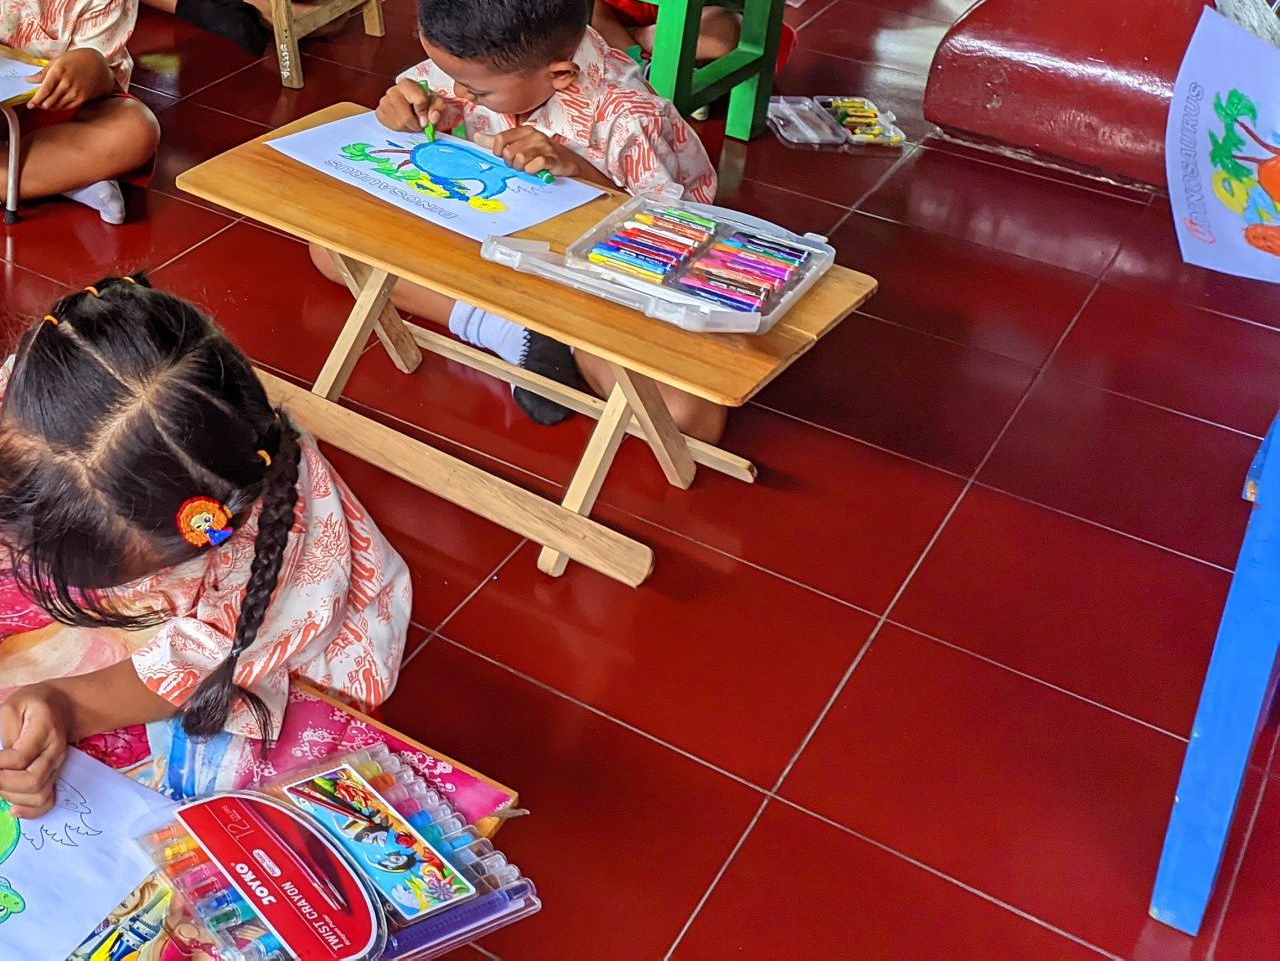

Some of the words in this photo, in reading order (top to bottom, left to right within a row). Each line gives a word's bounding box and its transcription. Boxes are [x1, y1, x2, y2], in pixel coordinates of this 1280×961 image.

[325, 160, 457, 219] DINOSAURUS
[226, 819, 255, 840] 12
[234, 861, 278, 906] JOYKO
[280, 879, 318, 923] CRAYON
[313, 921, 344, 951] TWIST
